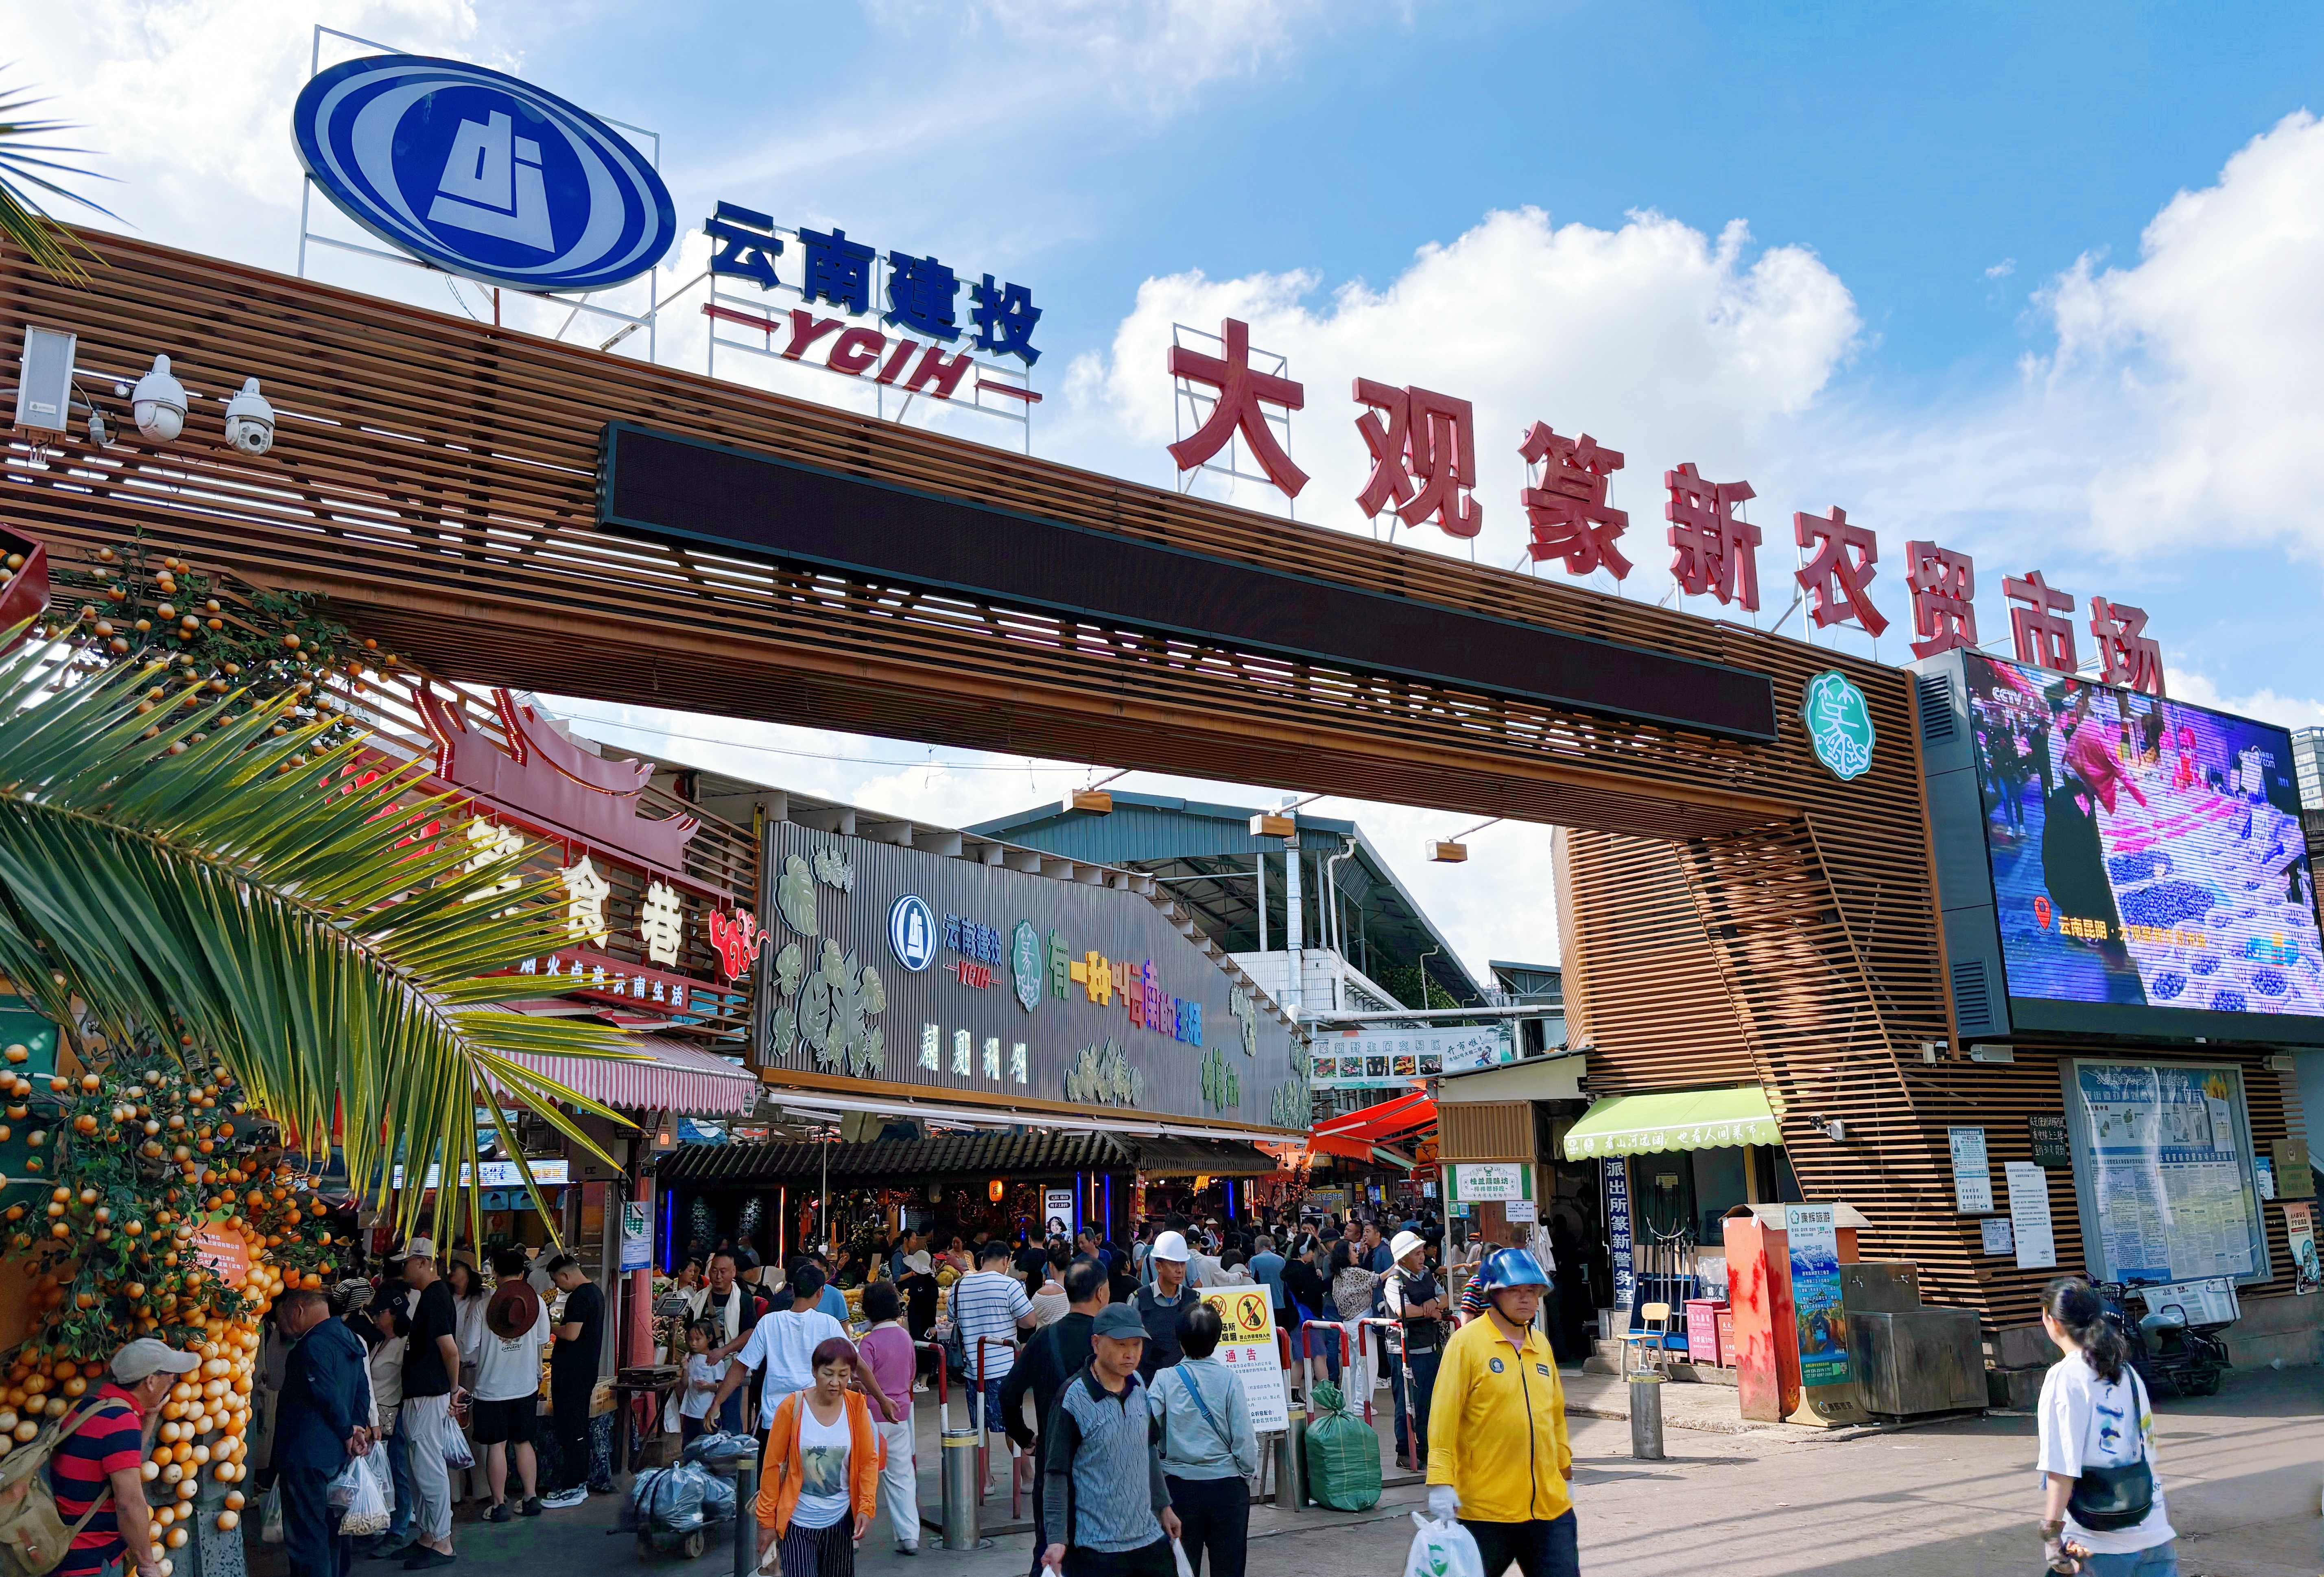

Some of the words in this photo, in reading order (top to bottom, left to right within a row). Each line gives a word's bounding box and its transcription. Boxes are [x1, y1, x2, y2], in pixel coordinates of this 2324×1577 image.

[703, 200, 1042, 366] 云南建投
[780, 309, 977, 400] YCIH
[1166, 317, 2165, 697] 大观篆新农贸市场
[1992, 687, 2022, 705] CCTV
[943, 913, 1002, 966] 云南建投
[958, 960, 991, 989] YCIH
[1047, 929, 1202, 1046] 有一种叫云南的生活
[1318, 1039, 1441, 1054] 篆新野生菌交易区
[1801, 1212, 1830, 1223] 康辉旅游
[1225, 1348, 1256, 1363] 通告
